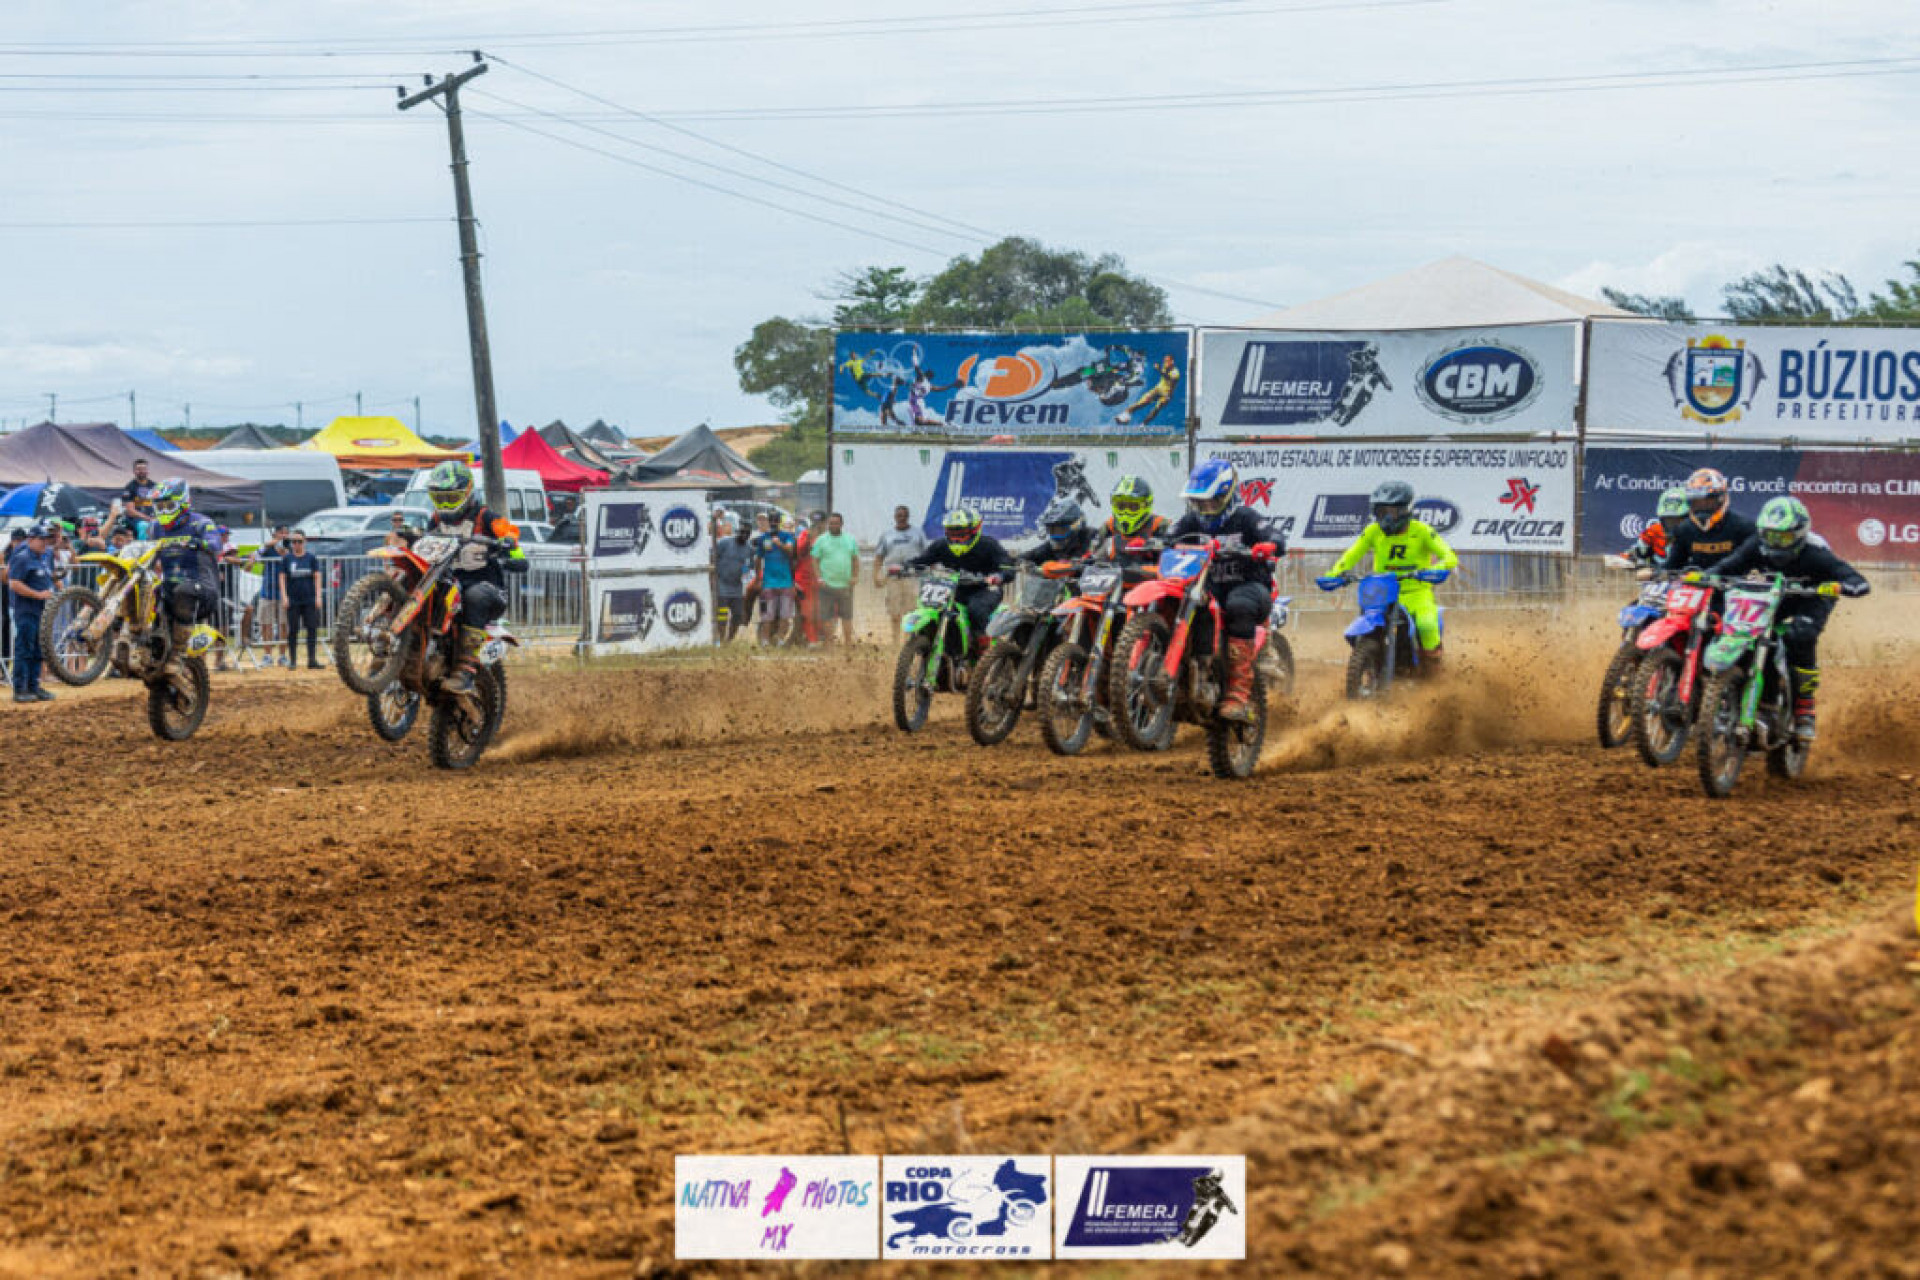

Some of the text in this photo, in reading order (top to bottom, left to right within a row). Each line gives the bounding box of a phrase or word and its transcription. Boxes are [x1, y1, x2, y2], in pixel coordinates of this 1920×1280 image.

[1779, 339, 1920, 401] BÚZIOS
[1260, 380, 1332, 396] FEMERJ
[1436, 362, 1521, 398] CBM
[945, 398, 1069, 424] Flevem
[1776, 402, 1920, 420] PREFEITURA
[1281, 449, 1334, 467] ESTADUAL
[1337, 449, 1352, 467] DE
[1354, 449, 1422, 467] MOTOCROSS
[1423, 449, 1431, 466] E
[1432, 449, 1507, 467] SUPERCROSS
[1509, 449, 1568, 468] UNIFICADO
[1595, 474, 1614, 490] Ar
[1749, 475, 1785, 492] você
[1788, 479, 1857, 494] encontra
[1861, 482, 1881, 494] na
[665, 518, 696, 538] CBM
[1890, 524, 1919, 543] LG
[1389, 544, 1407, 559] R
[1671, 590, 1705, 608] 51
[668, 601, 698, 622] CBM
